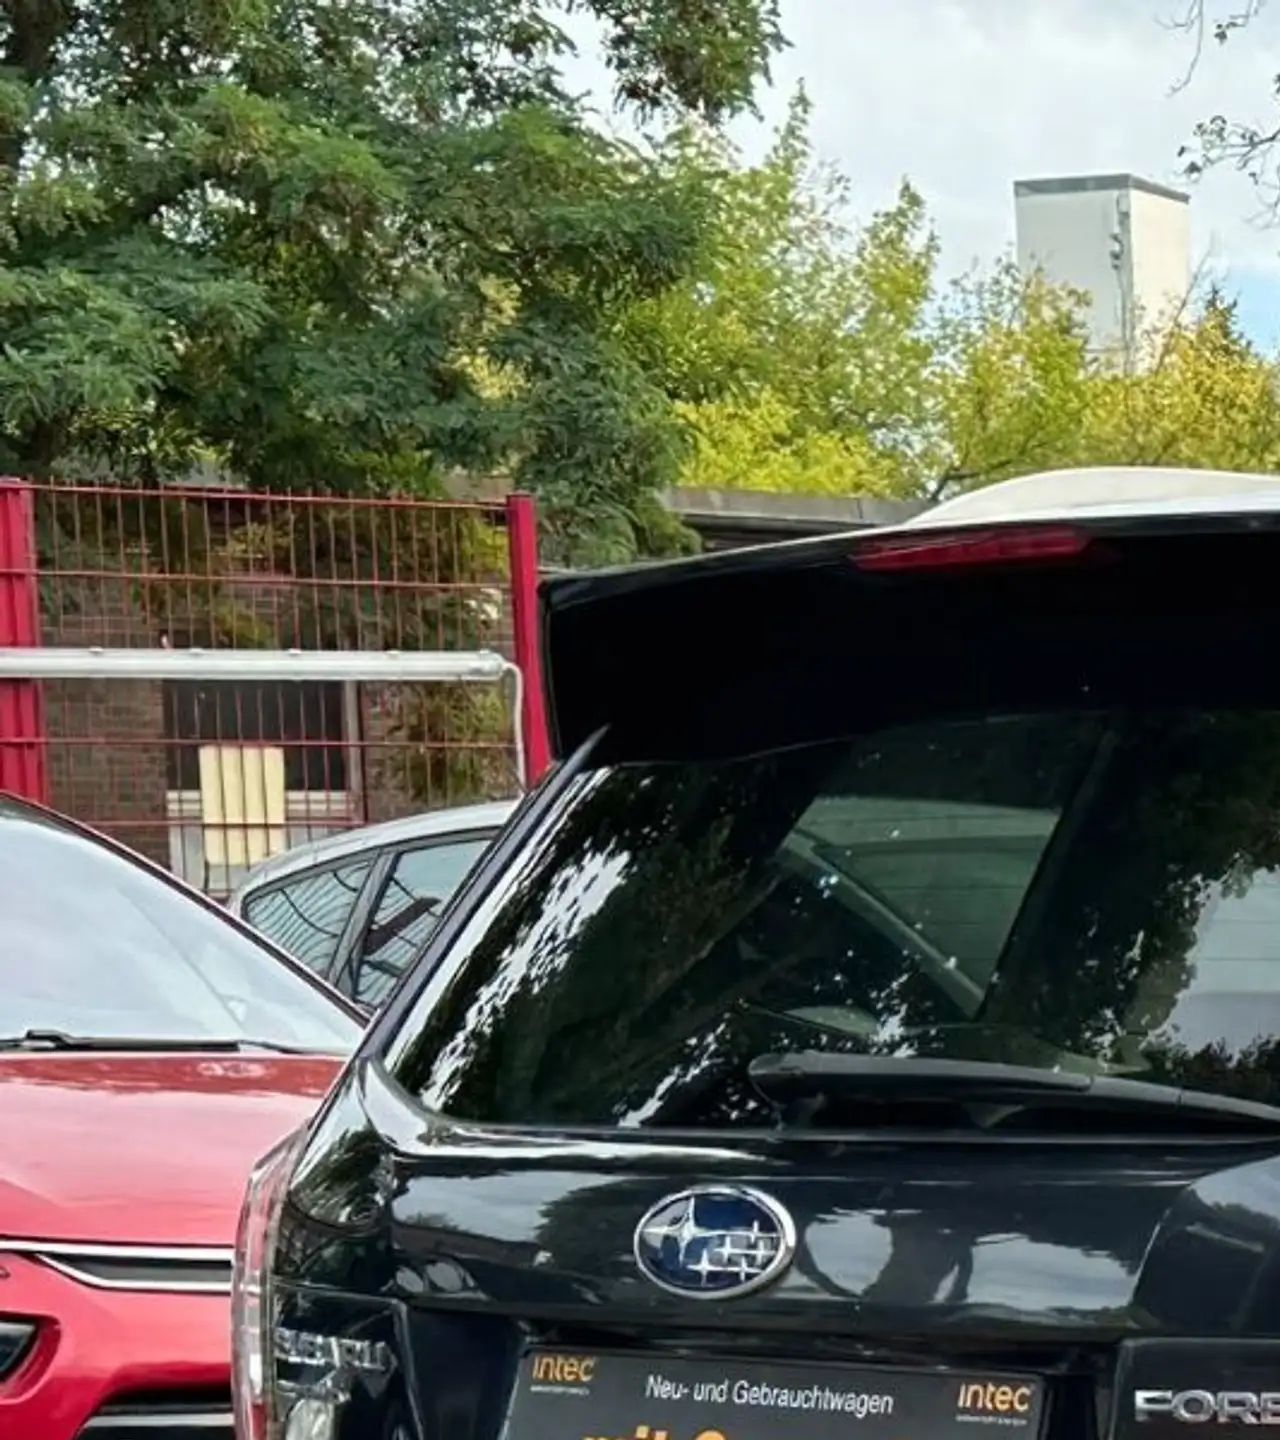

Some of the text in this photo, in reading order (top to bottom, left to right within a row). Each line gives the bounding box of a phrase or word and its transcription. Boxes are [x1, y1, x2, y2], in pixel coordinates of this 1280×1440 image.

[532, 1354, 596, 1382] intec
[645, 1374, 894, 1419] Neu- und Gebrauchtwagen
[957, 1381, 1031, 1412] intec
